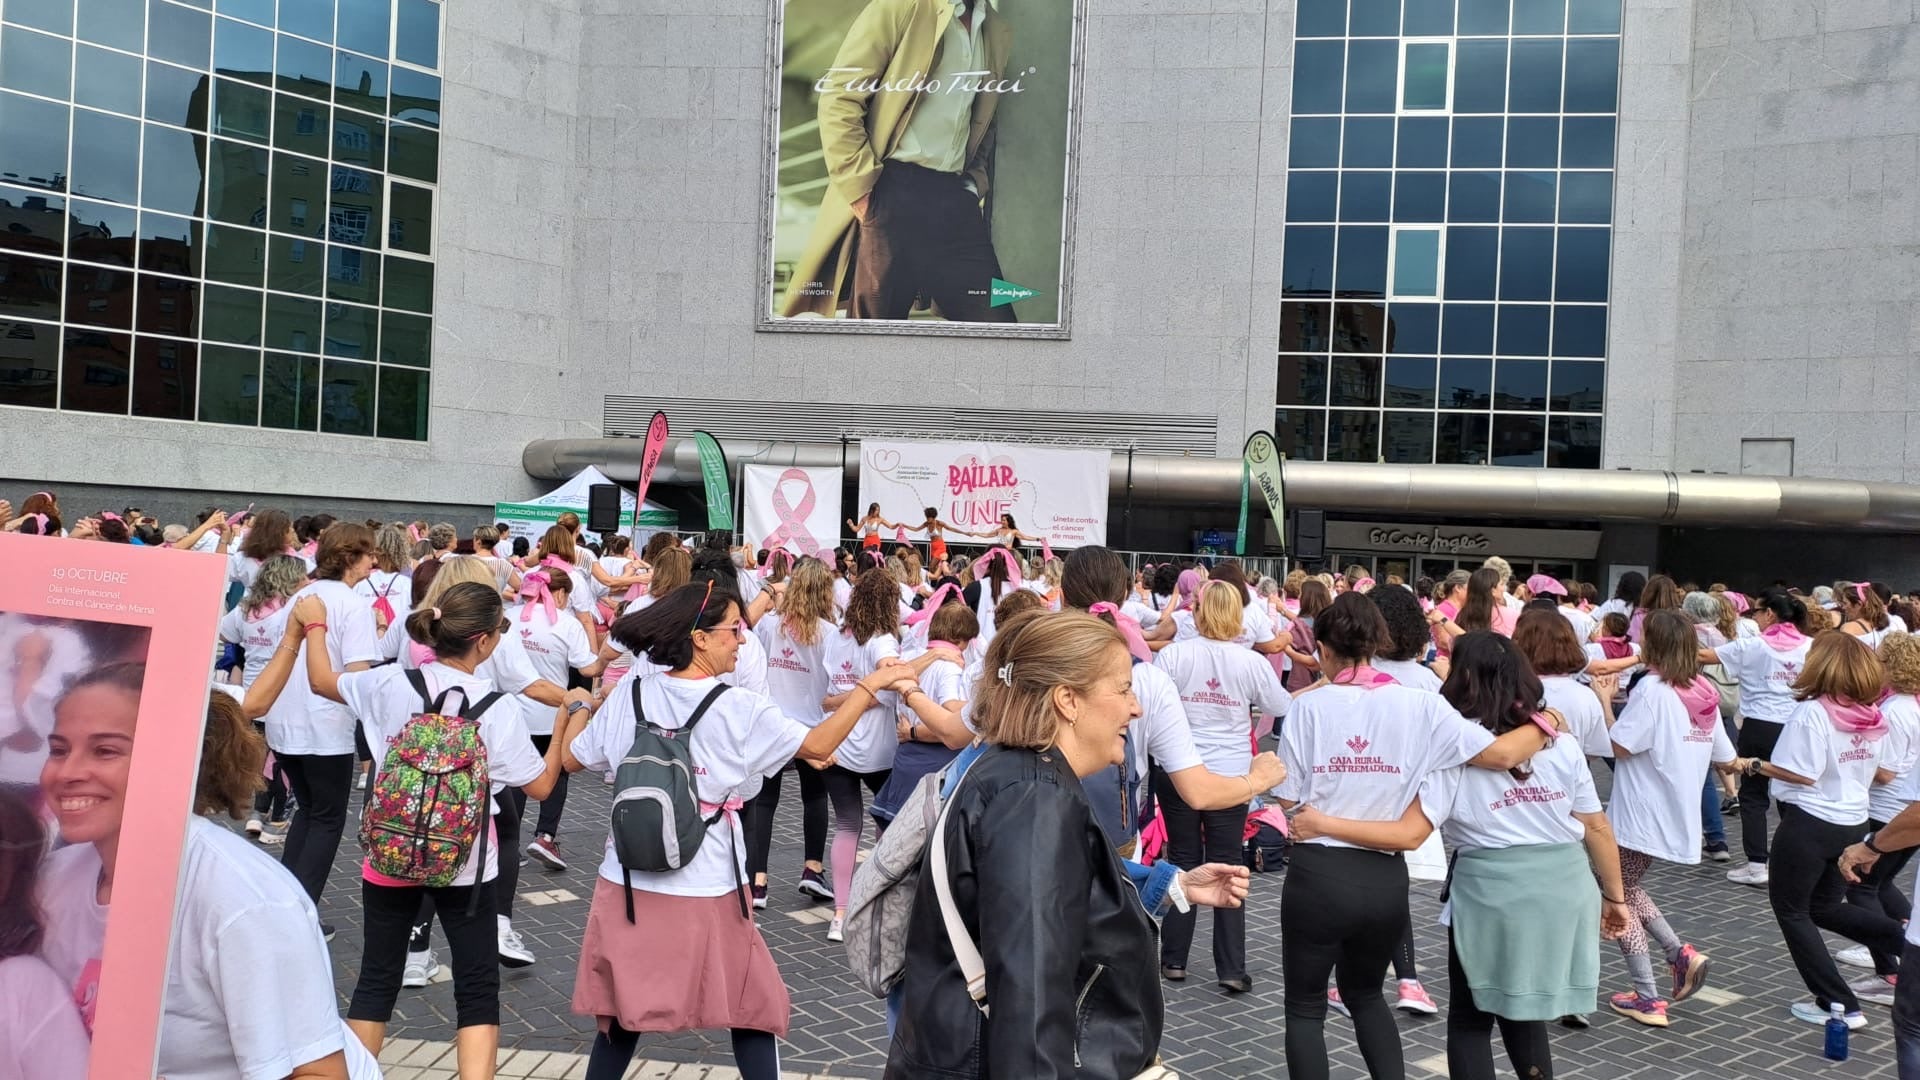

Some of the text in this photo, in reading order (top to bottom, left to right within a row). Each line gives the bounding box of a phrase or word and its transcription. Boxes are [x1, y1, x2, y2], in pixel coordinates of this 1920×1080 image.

[814, 67, 1025, 95] Emidio Tucci
[948, 459, 1018, 496] BAILAR
[951, 499, 1013, 526] UNE
[1370, 526, 1490, 554] El Corte Inglés
[52, 567, 129, 585] 19 OCTUBRE
[65, 585, 121, 600] Internacional
[46, 595, 74, 607] Contra
[75, 599, 83, 608] el
[115, 603, 127, 611] de
[128, 604, 155, 615] Mama
[1190, 697, 1241, 707] EXTREMADURA
[1193, 690, 1230, 701] CAJA RURAL
[1329, 756, 1384, 766] CAJA RURAL
[1312, 764, 1401, 774] DE EXTREMADURA
[1524, 785, 1551, 796] URAL
[1489, 800, 1503, 811] DE
